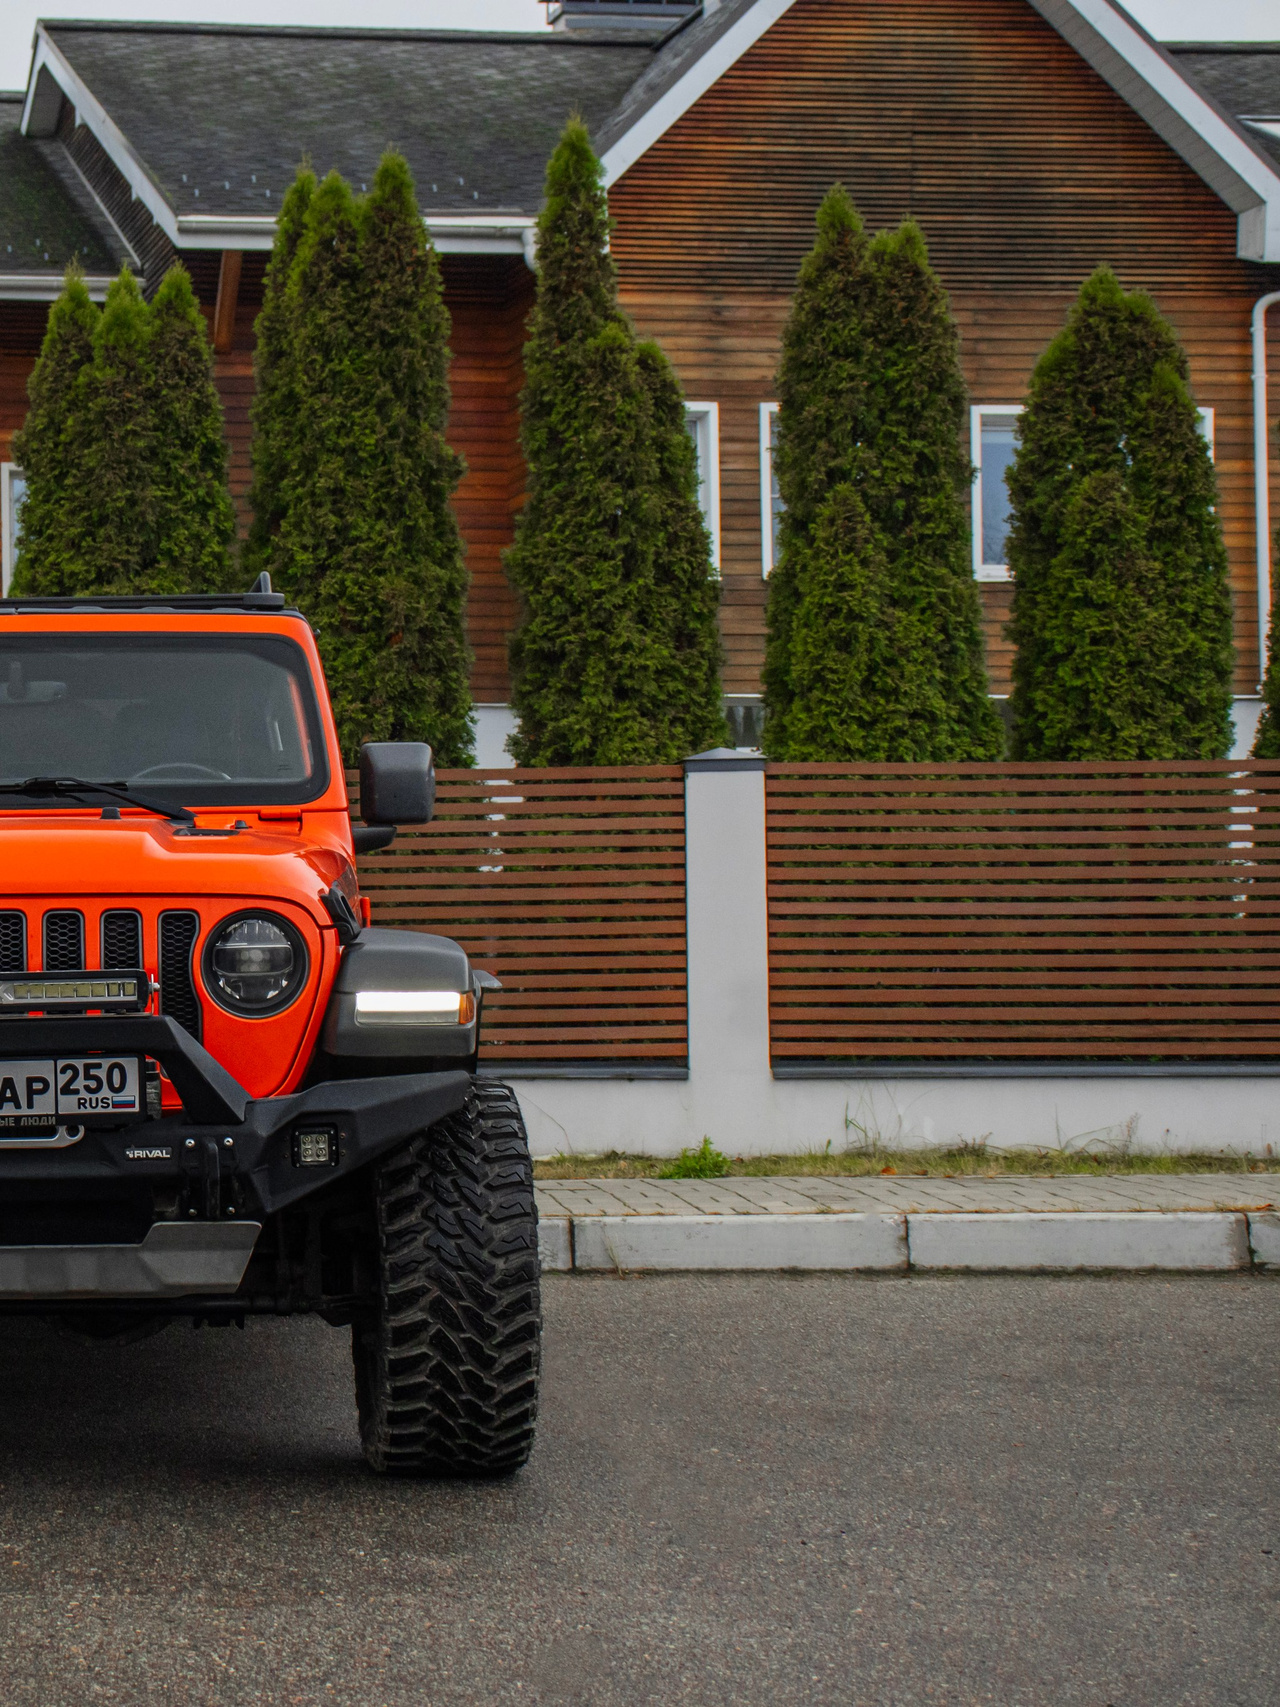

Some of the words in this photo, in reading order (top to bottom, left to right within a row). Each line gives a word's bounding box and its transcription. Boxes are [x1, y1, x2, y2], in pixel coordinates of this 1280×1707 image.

[59, 1061, 128, 1096] 250
[77, 1095, 111, 1110] RUS
[20, 1116, 56, 1126] ЛЮДИ
[134, 1150, 171, 1158] RIVAL
